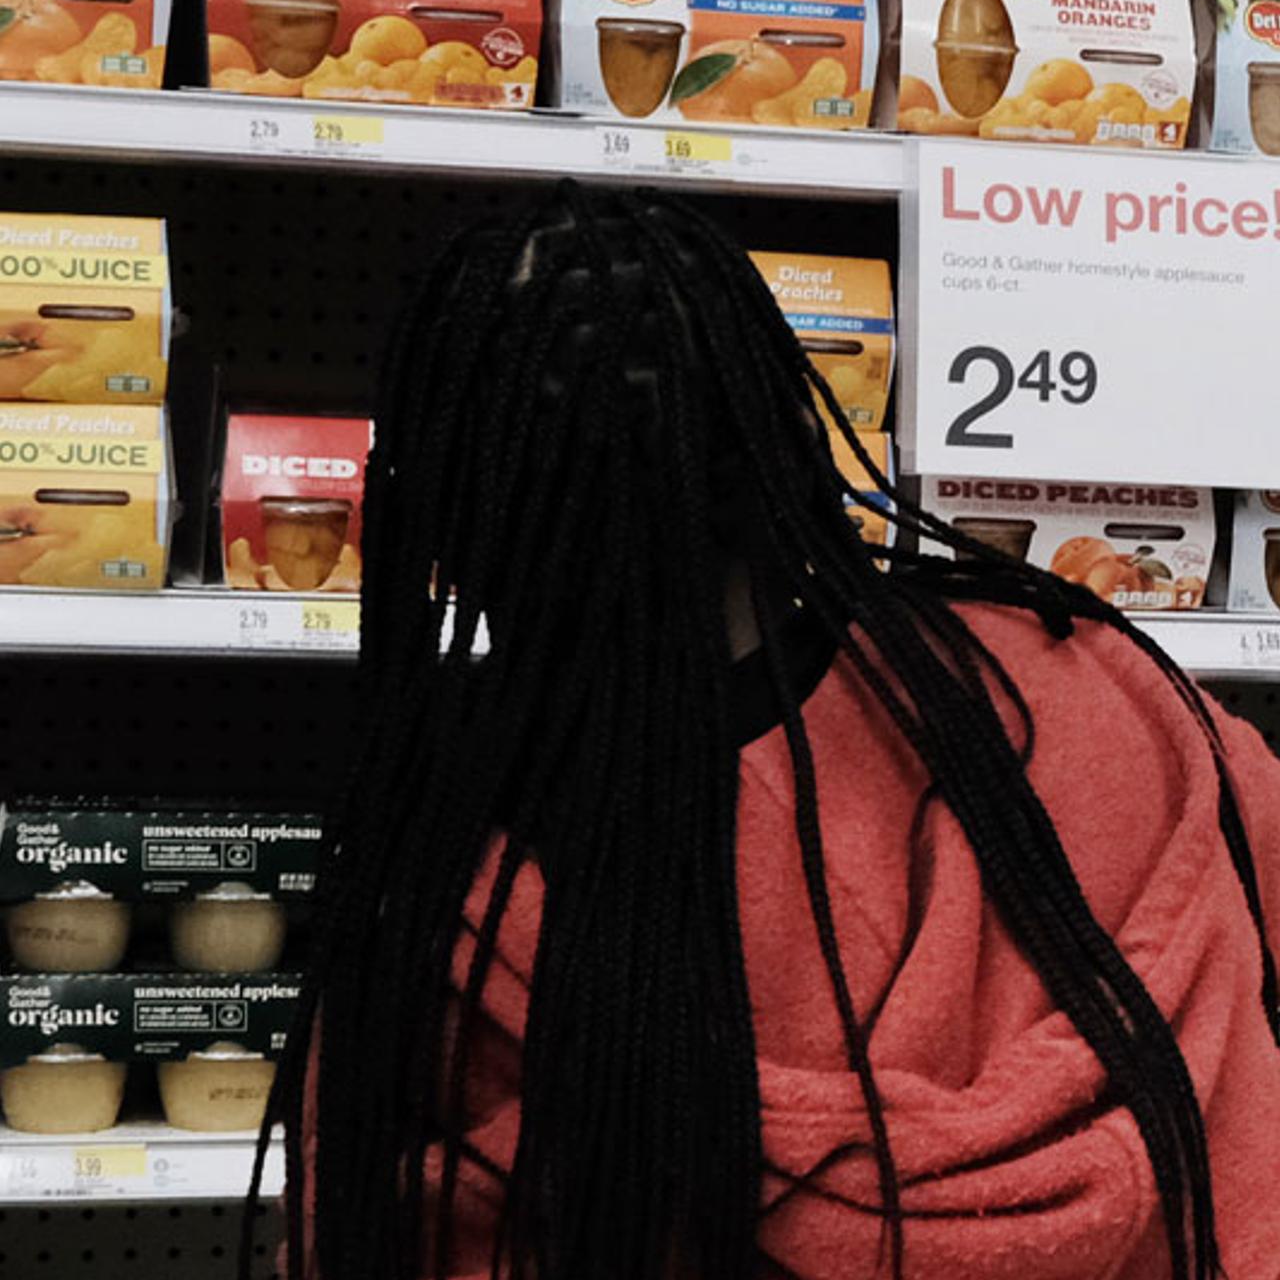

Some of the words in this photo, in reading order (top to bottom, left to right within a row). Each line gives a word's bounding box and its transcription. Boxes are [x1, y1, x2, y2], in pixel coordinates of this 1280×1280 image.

[1058, 10, 1151, 31] ORANGES
[1252, 12, 1276, 31] Del
[250, 121, 279, 139] 2.79
[314, 123, 344, 142] 2.79
[941, 166, 1082, 227] Low
[58, 229, 139, 249] Peaches
[59, 258, 152, 282] JUICE
[942, 252, 988, 270] Good
[992, 256, 1005, 271] &
[1008, 257, 1063, 275] Gather
[1067, 260, 1150, 281] homestyle
[1154, 265, 1245, 285] applesauce
[942, 275, 981, 293] cups
[241, 454, 358, 478] DICED
[937, 479, 1039, 503] DICED
[1046, 485, 1199, 509] PEACHES
[143, 824, 248, 839] unsweetened
[17, 842, 128, 872] organic
[134, 987, 240, 999] unsweetened
[9, 1005, 120, 1034] organic
